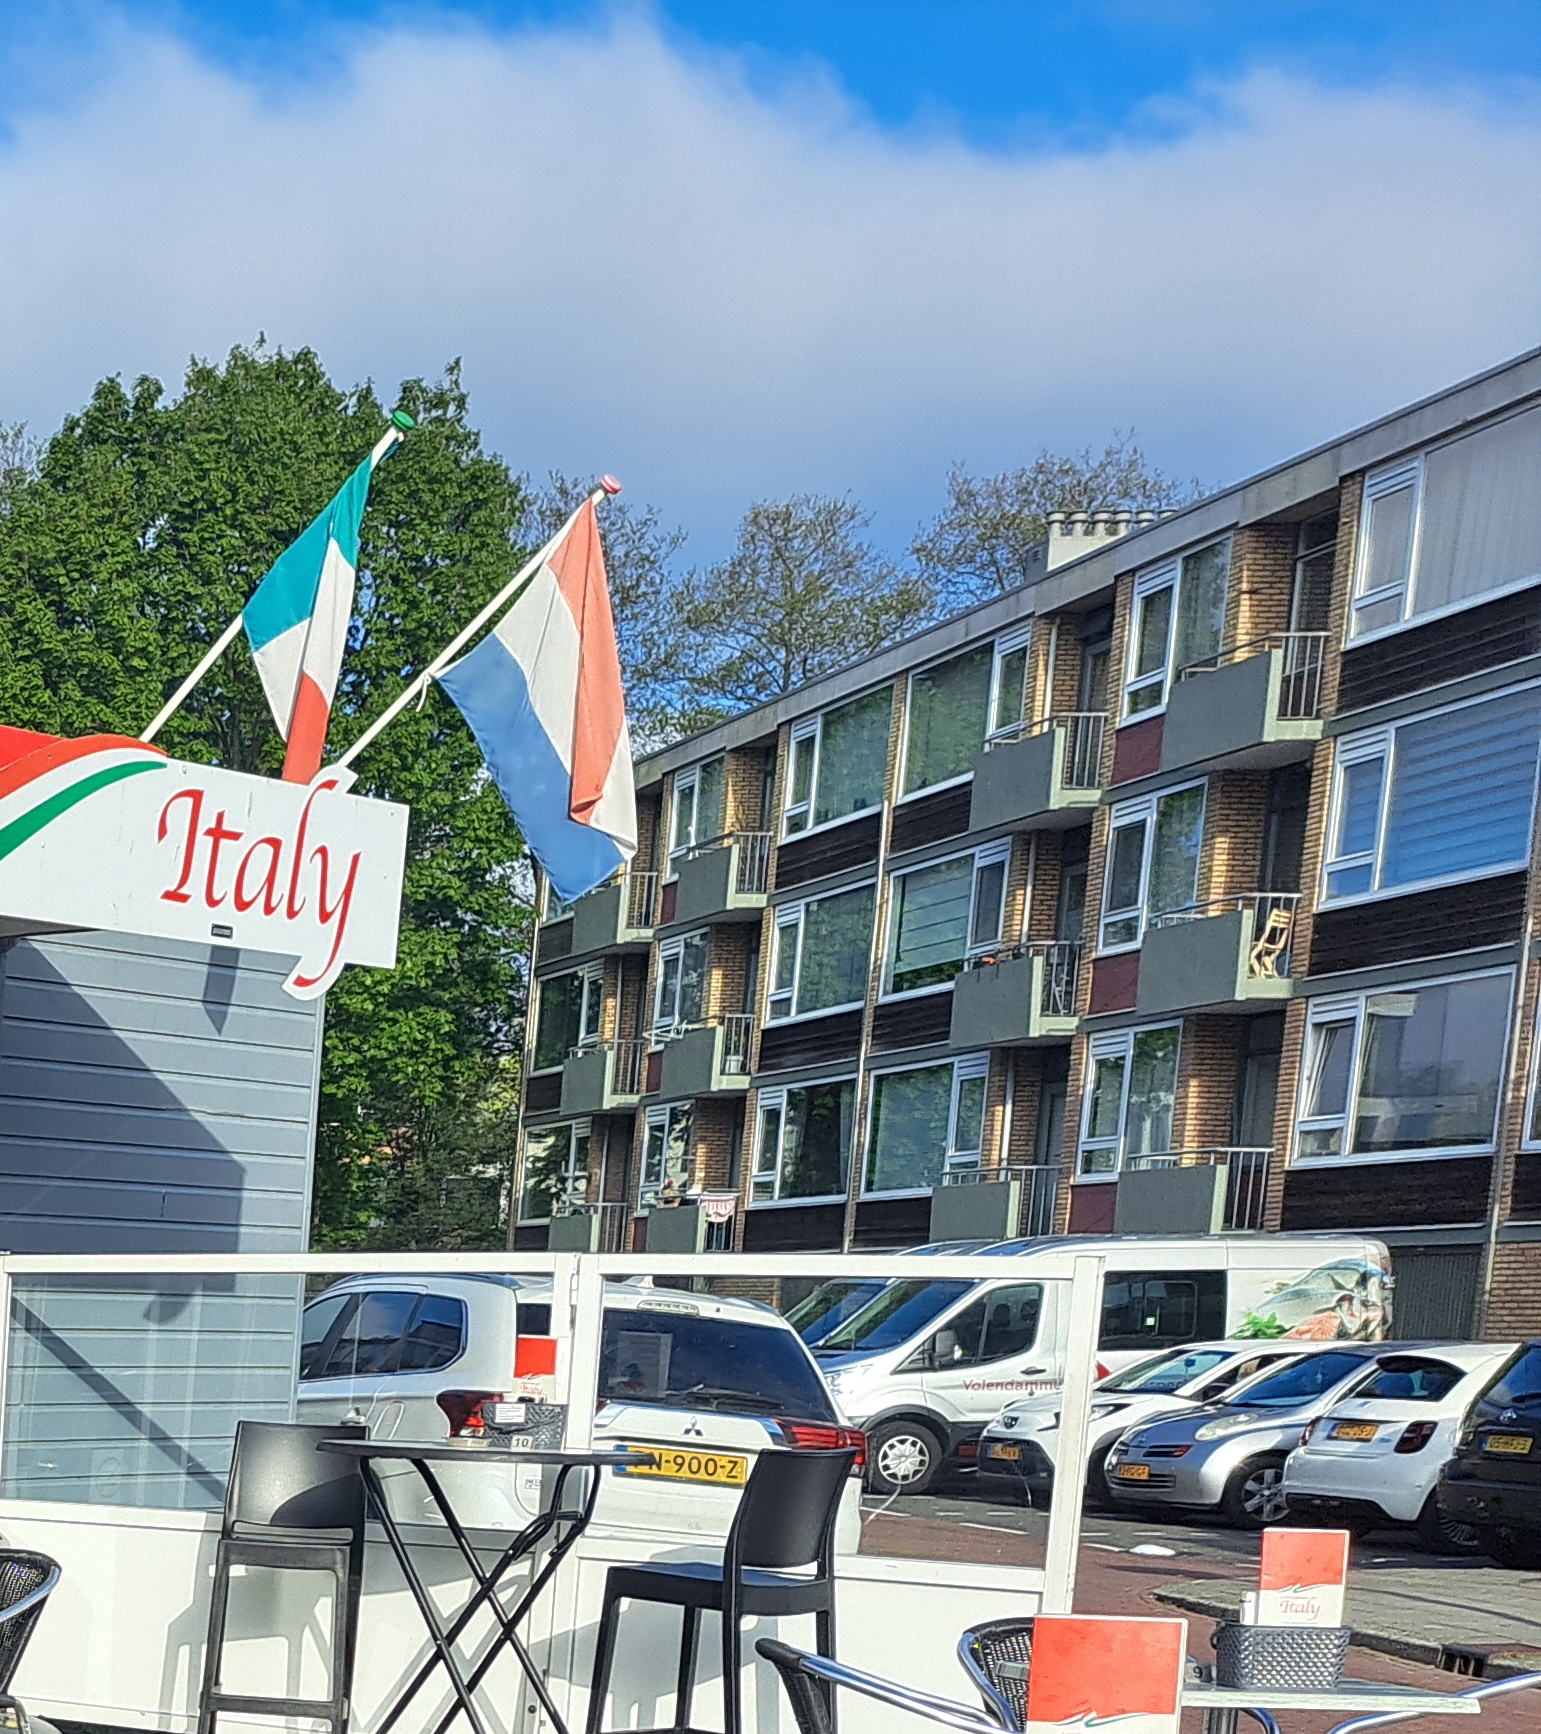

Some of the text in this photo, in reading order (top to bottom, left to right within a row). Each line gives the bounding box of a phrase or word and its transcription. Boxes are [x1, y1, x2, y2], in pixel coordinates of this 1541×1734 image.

[156, 778, 362, 988] Italy
[962, 1379, 1062, 1392] Volendamme
[515, 1438, 530, 1448] 10
[1279, 1596, 1322, 1622] Italy
[1192, 1665, 1204, 1679] 9
